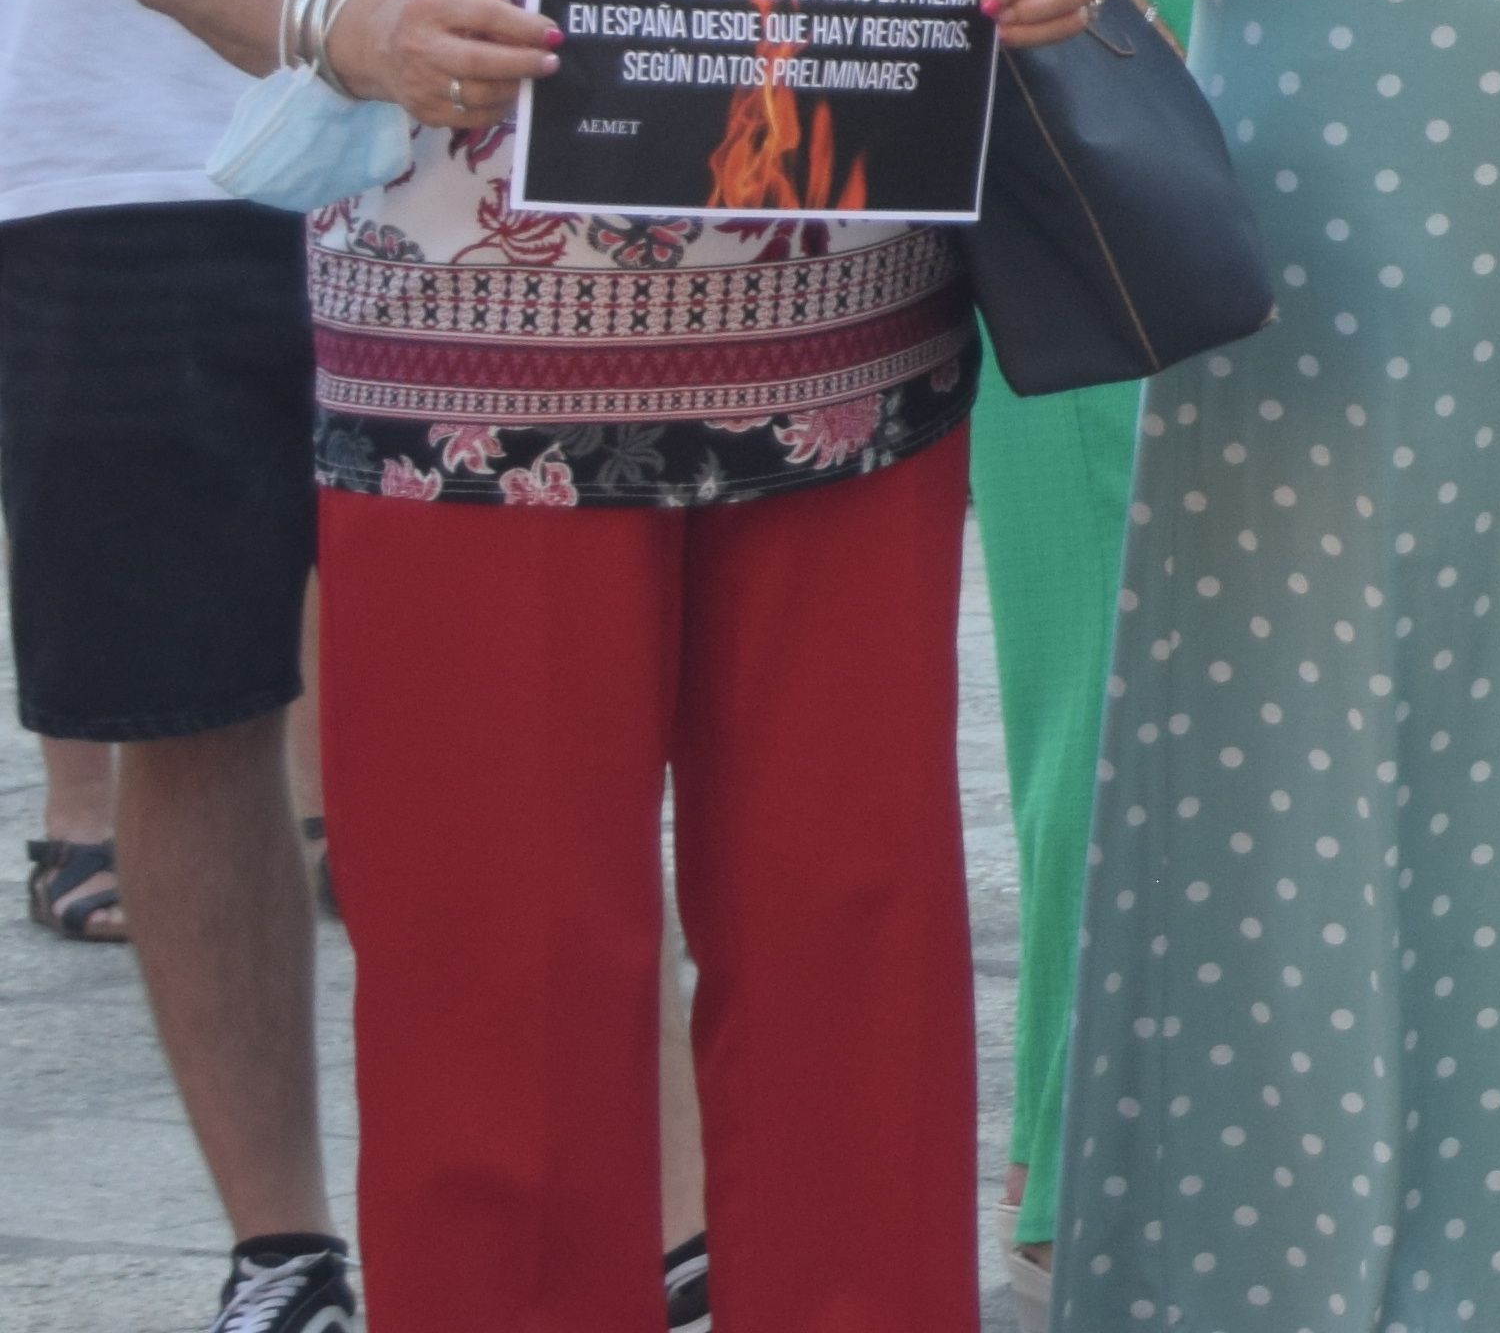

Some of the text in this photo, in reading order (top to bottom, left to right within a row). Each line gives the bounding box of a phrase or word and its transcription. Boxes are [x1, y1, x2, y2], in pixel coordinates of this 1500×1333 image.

[569, 1, 971, 51] EN ESPAÑA DESDE QUE HAY REGISTROS,
[623, 47, 920, 92] SEGÚN DATOS PRELIMINARES
[577, 119, 641, 136] AEMET
